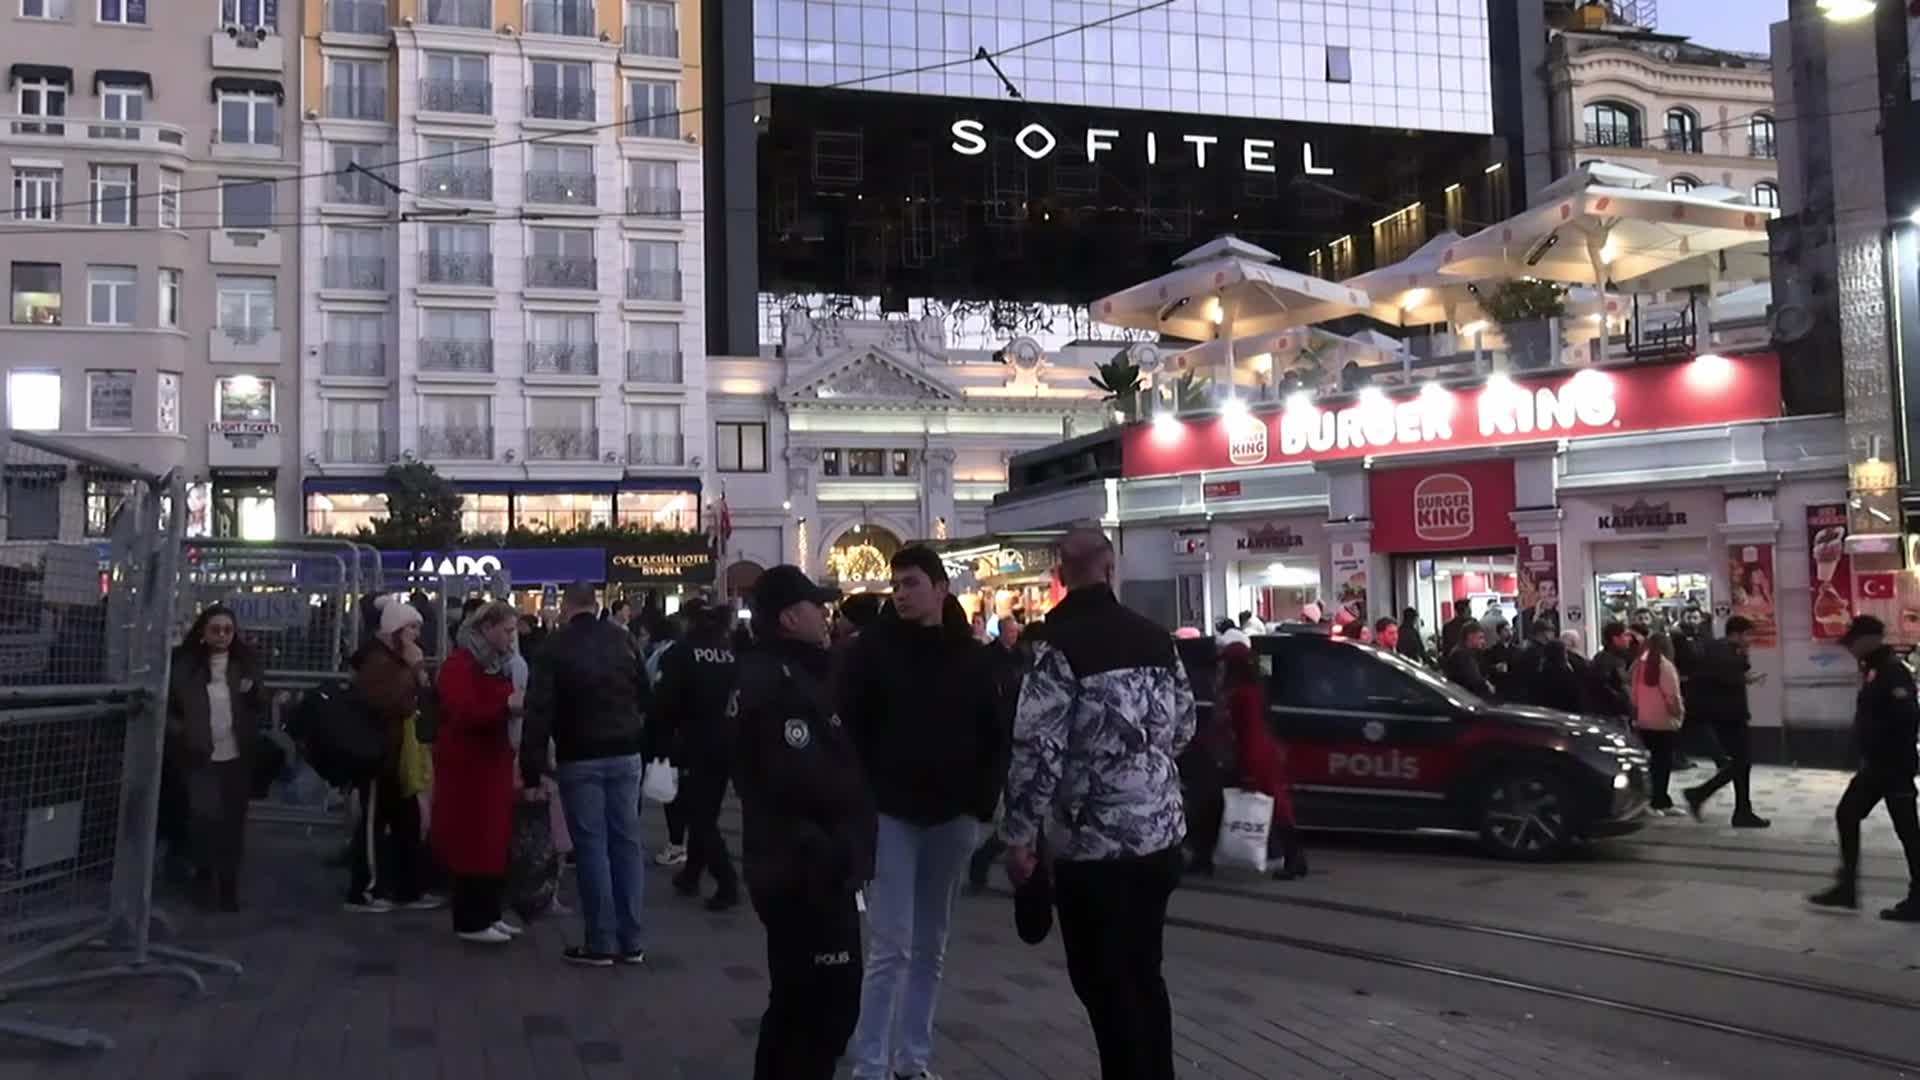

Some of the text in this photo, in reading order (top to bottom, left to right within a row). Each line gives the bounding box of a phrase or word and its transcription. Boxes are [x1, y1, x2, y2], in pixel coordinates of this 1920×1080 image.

[952, 119, 1334, 175] SOFITEL
[1281, 380, 1616, 455] BURGER KING
[210, 422, 280, 433] FLIGHT TICKETS
[1233, 441, 1265, 456] KING
[1417, 495, 1470, 509] BURGER
[1418, 507, 1471, 527] KING
